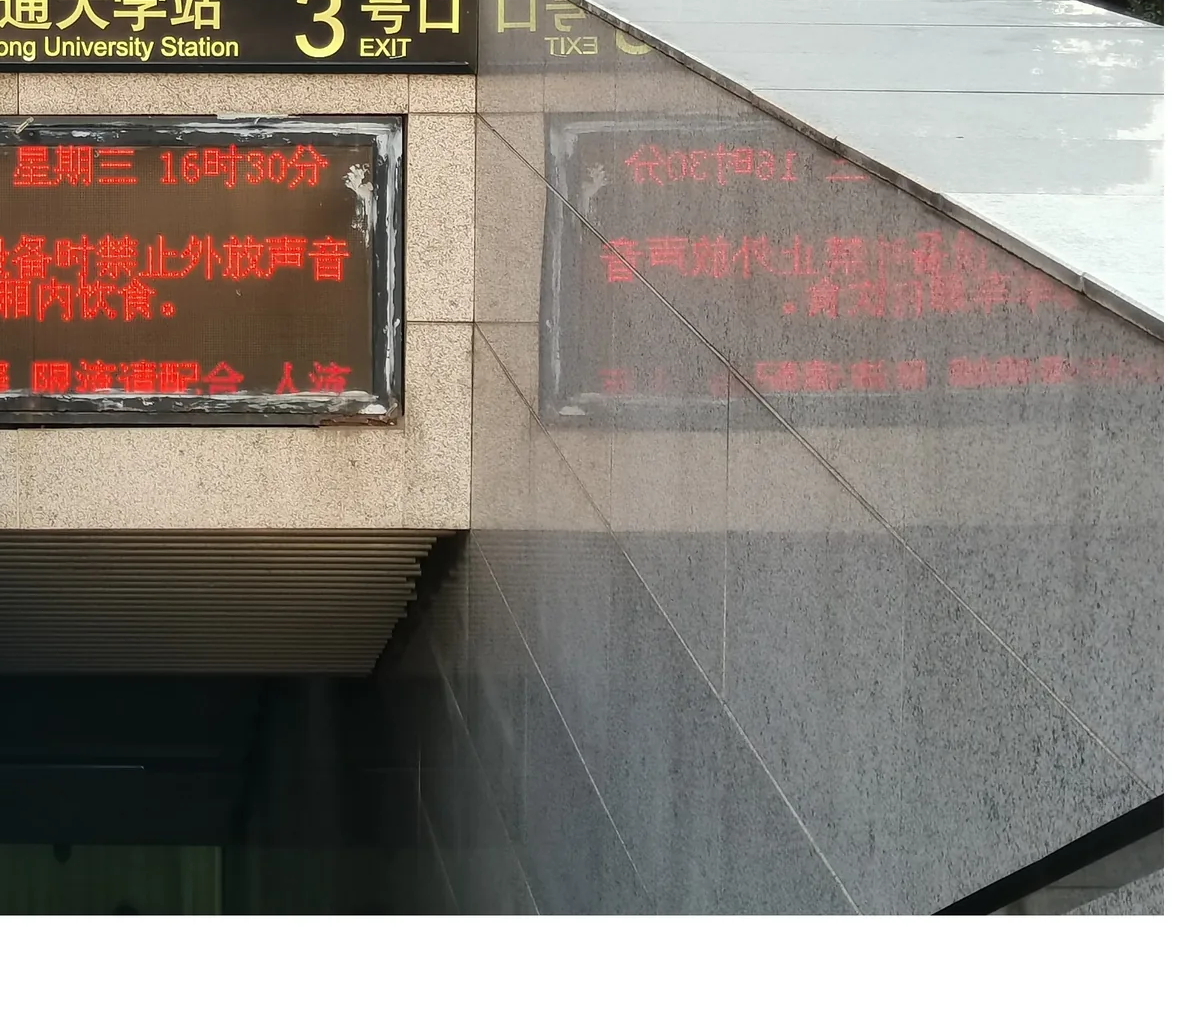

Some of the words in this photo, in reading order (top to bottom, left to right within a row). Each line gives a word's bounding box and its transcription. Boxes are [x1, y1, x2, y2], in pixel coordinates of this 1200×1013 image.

[44, 35, 155, 62] University
[160, 35, 239, 57] Station
[359, 37, 412, 58] EXIT
[13, 145, 138, 187] 星期三
[161, 144, 329, 189] 16时30分
